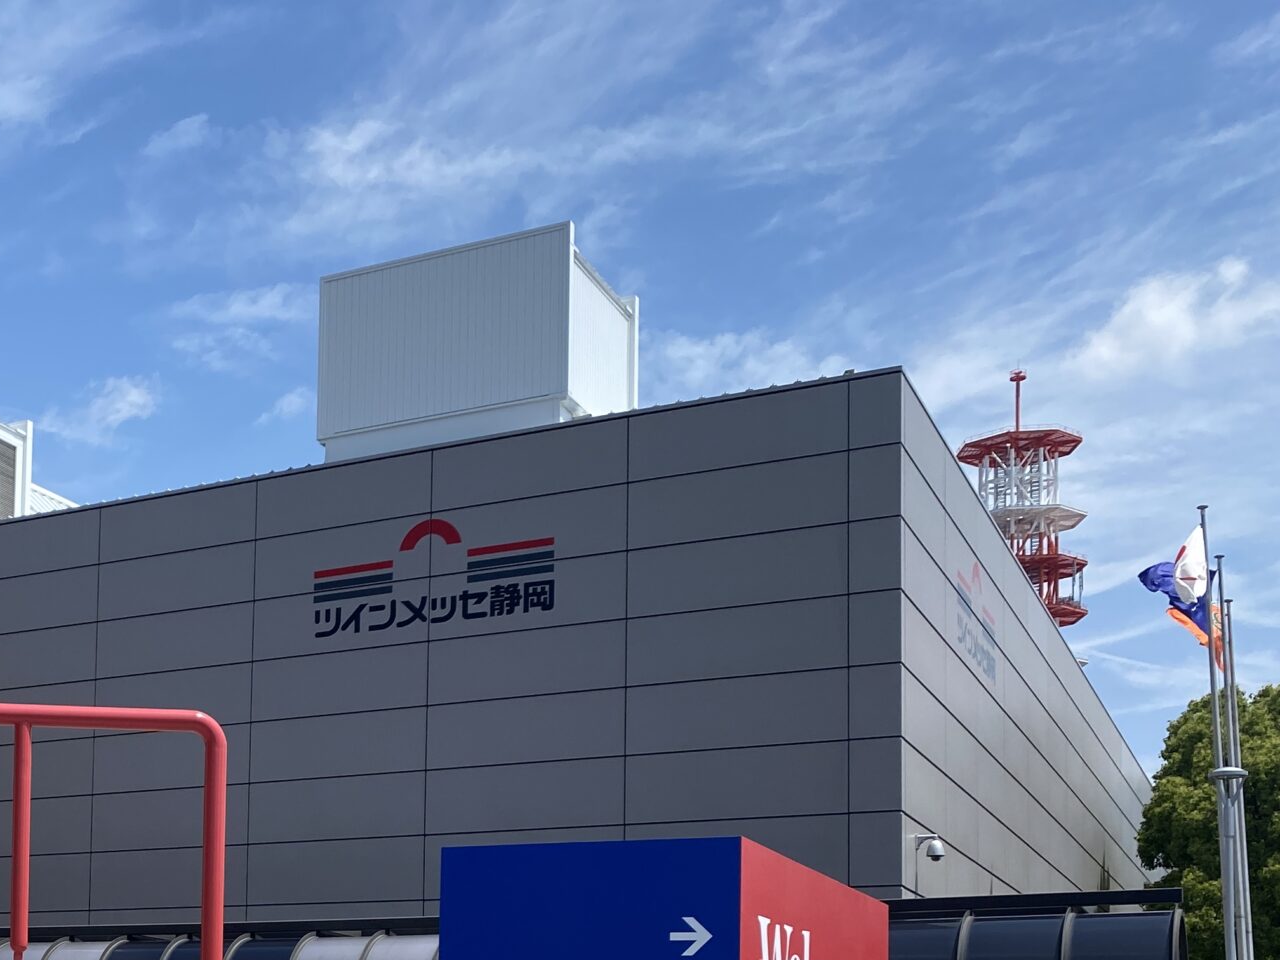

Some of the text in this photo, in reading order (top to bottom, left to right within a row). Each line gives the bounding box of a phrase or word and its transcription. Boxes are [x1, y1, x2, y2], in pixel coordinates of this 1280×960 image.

[314, 579, 555, 638] ツインメッセ静岡
